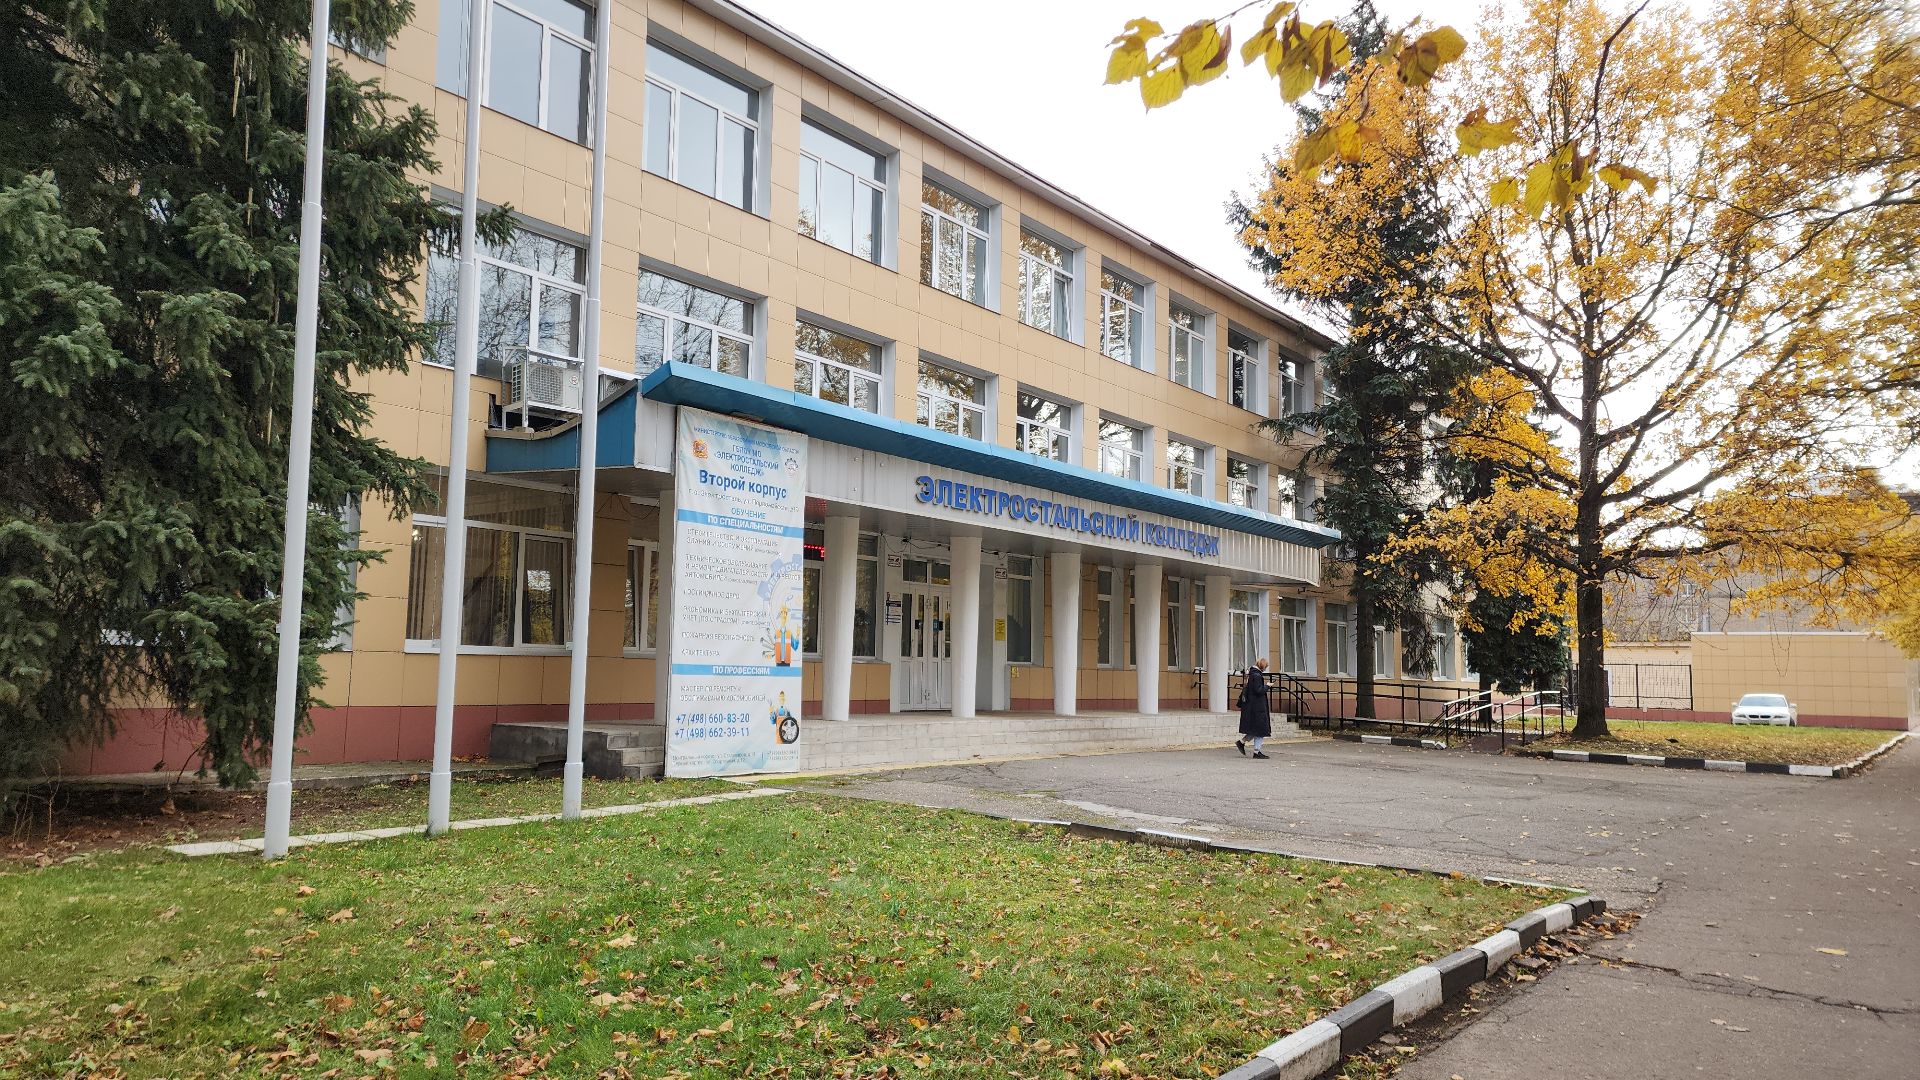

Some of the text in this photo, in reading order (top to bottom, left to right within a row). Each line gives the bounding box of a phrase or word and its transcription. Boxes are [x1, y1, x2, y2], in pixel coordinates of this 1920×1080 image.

[752, 449, 762, 458] МО
[730, 463, 764, 477] КОЛЛЕДЖ»
[699, 469, 787, 501] Второй корпус
[731, 507, 767, 520] ОБУЧЕНИЕ
[915, 475, 1220, 558] ЭЛЕКТРОСТАЛЬСКИЙ КОЛЛЕДЖ
[707, 515, 784, 534] ПО СПЕЦИАЛЬНОСТЯМ
[681, 648, 721, 657] АРХИТЕКТУРА
[712, 665, 771, 675] ПО ПРОФЕССИЯМ
[680, 685, 704, 693] МАСТЕР
[675, 712, 750, 727] +7 (498) 660-83-20
[674, 726, 750, 741] +7 (498) 662-39-11
